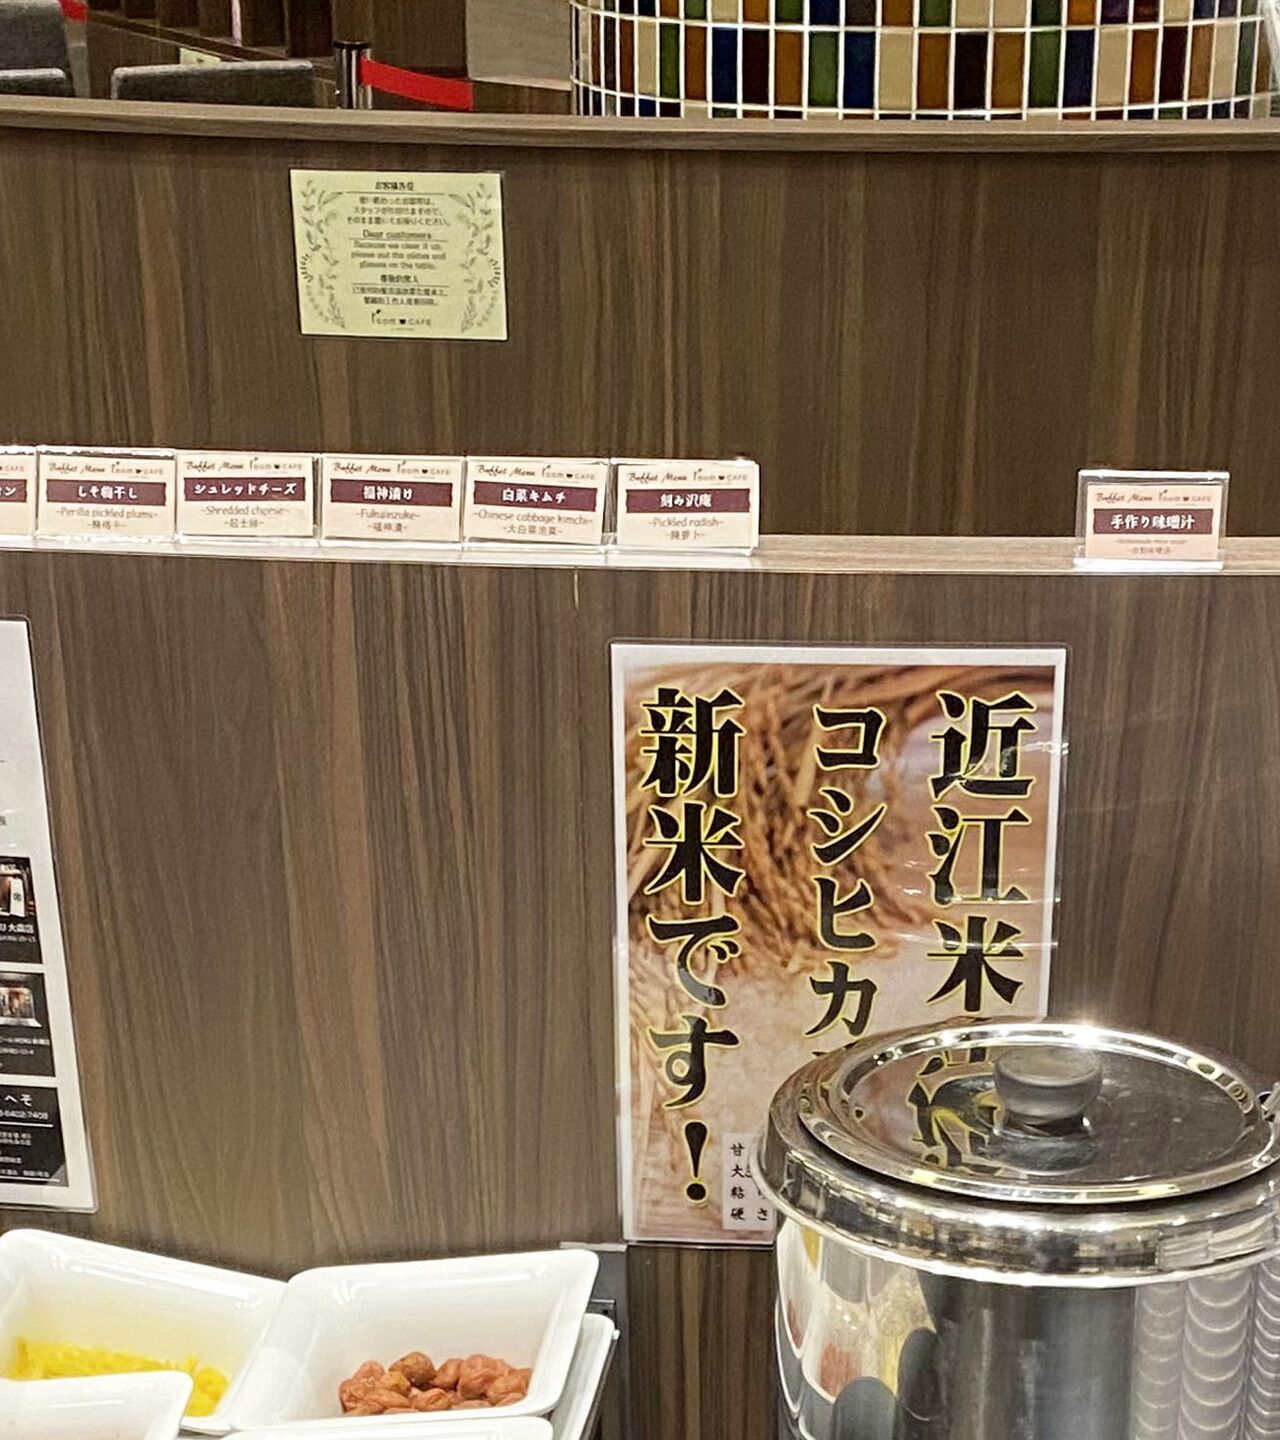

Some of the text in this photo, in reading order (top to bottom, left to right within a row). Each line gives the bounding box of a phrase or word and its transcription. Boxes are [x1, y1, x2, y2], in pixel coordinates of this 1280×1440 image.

[78, 485, 138, 499] しそ梅干し
[194, 483, 297, 496] シュレッドチーズ
[363, 485, 412, 500] 福神漬け
[502, 488, 566, 504] 白菜キムチ
[1110, 514, 1196, 530] 手作り味噌汁
[926, 690, 1037, 1013] 近江米
[804, 703, 887, 1056] コシヒカ
[639, 686, 745, 1203] 新米です！
